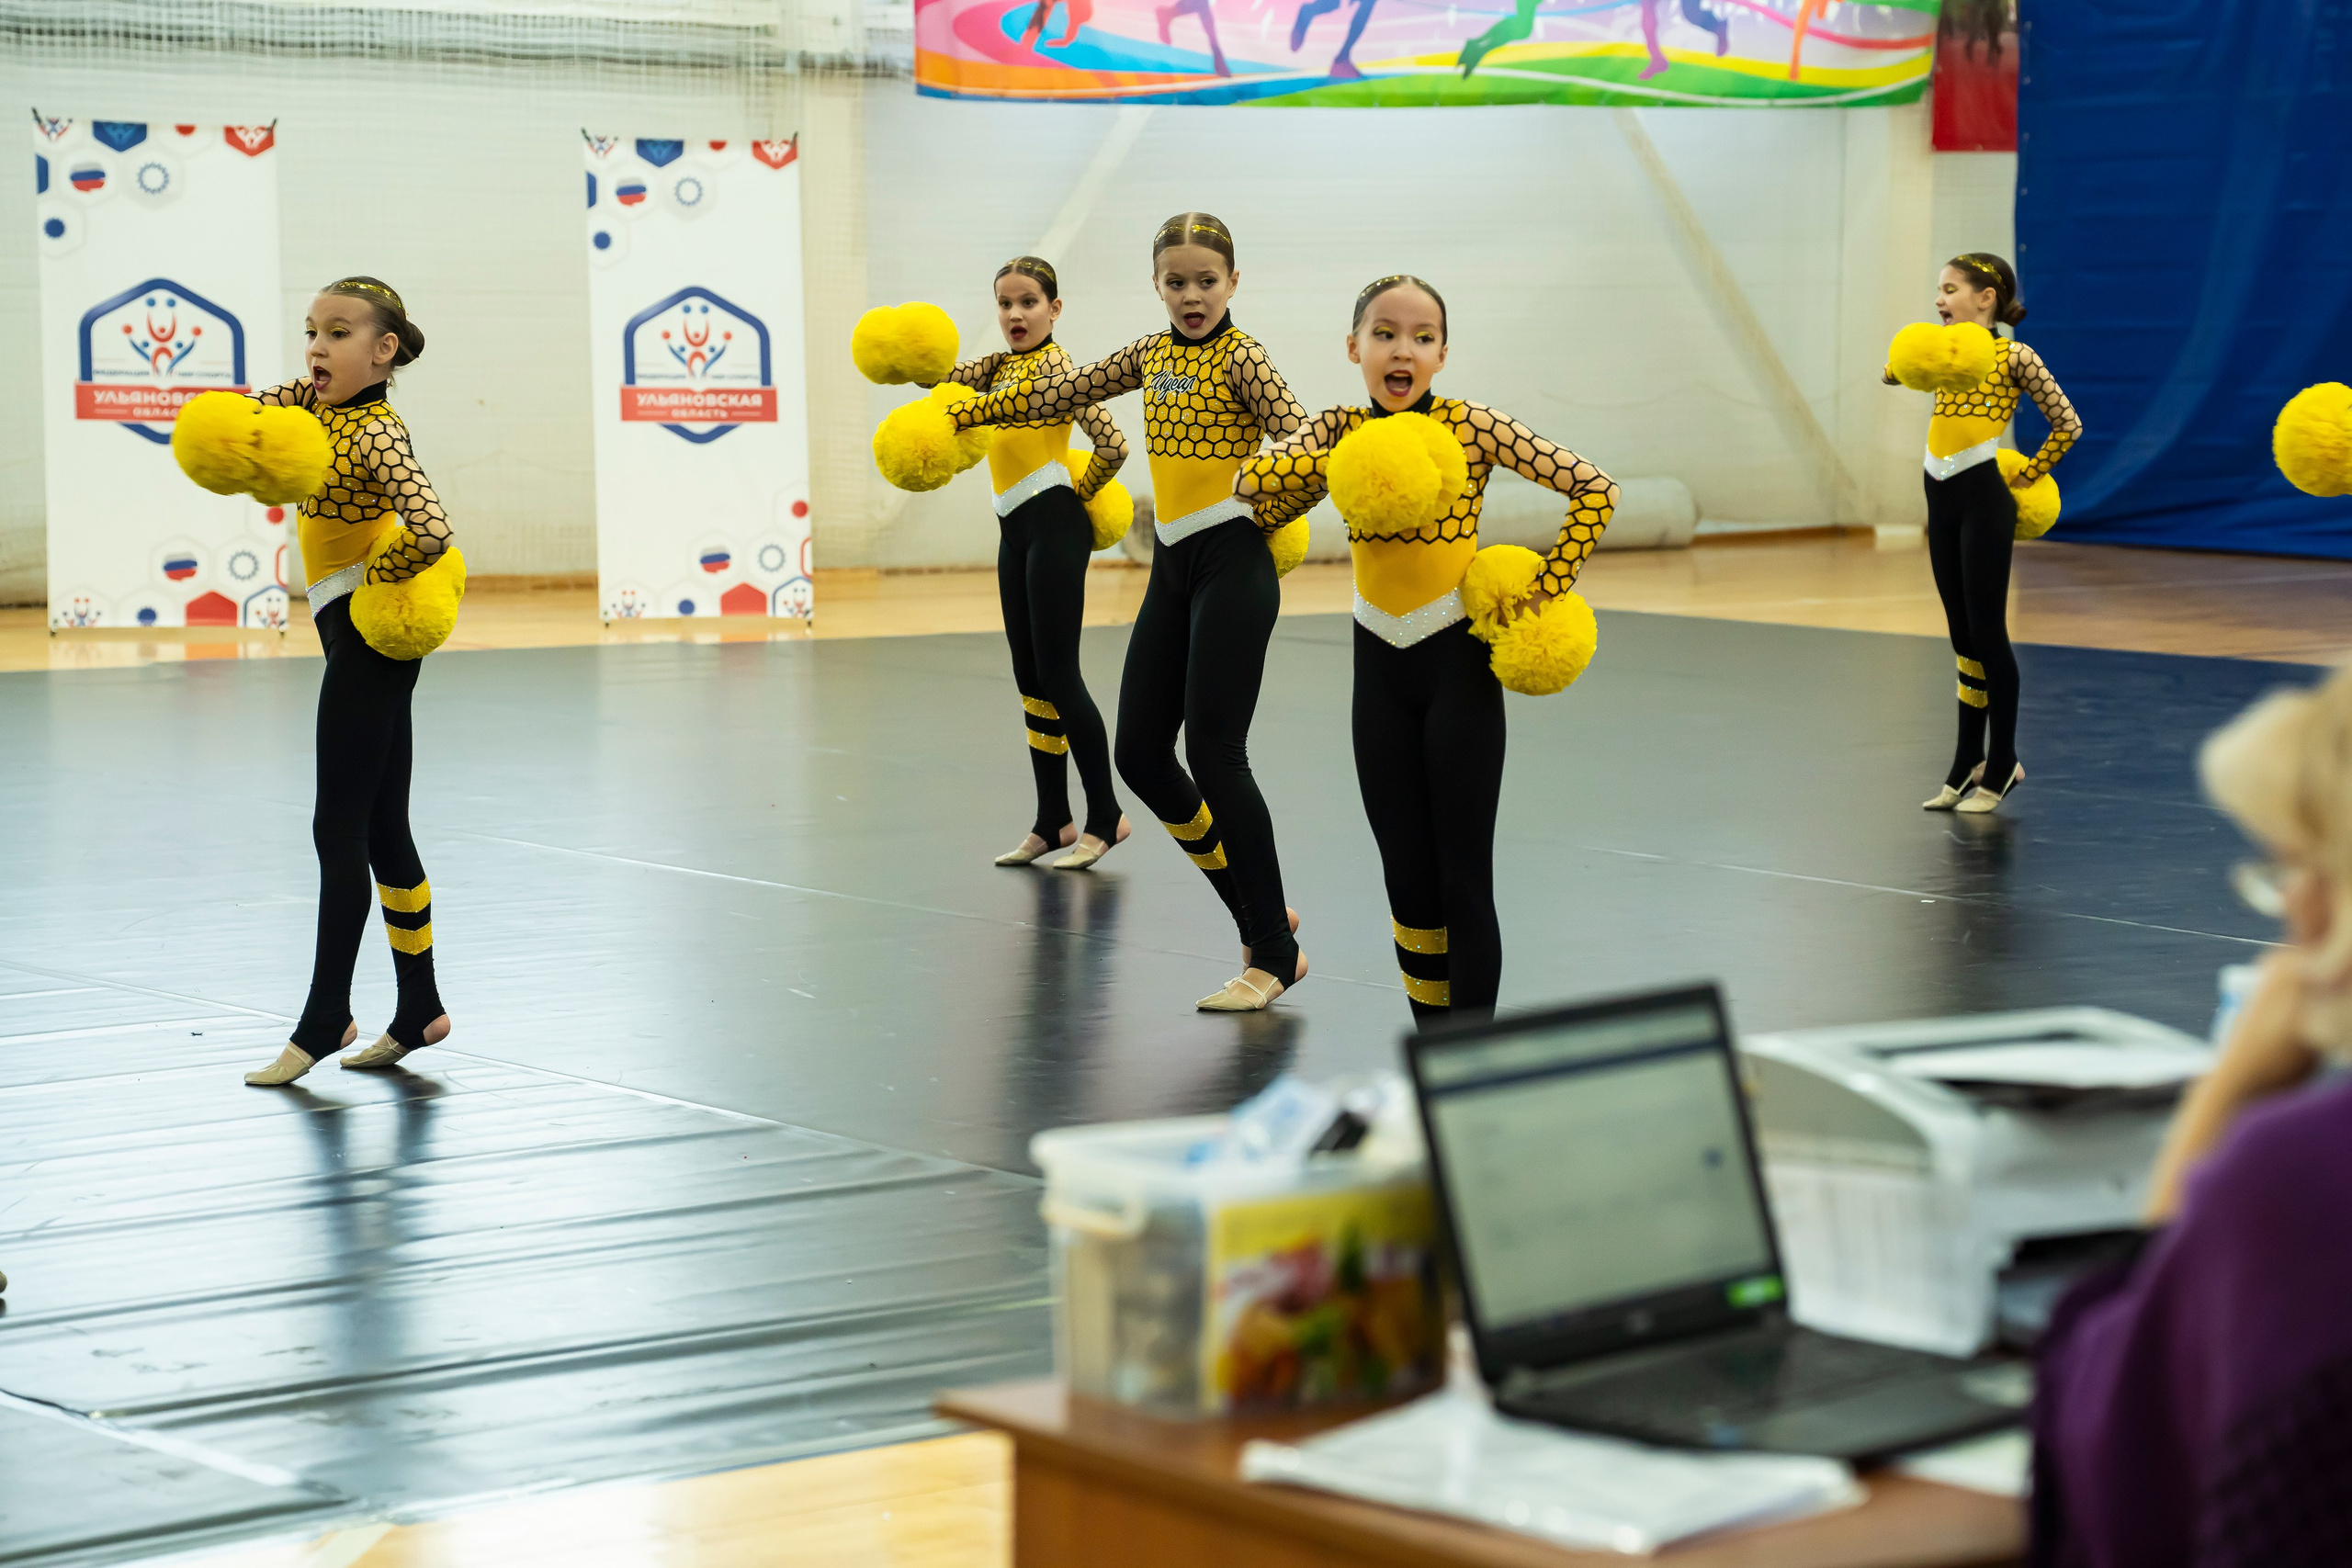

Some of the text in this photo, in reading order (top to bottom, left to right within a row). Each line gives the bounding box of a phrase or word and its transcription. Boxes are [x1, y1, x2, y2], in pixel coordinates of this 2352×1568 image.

[94, 390, 198, 406] УЛЬЯНОВС
[637, 393, 763, 407] УЛЬЯНОВСКАЯ
[133, 407, 181, 417] ОБЛАС
[671, 409, 729, 419] ОБЛАСТЬ
